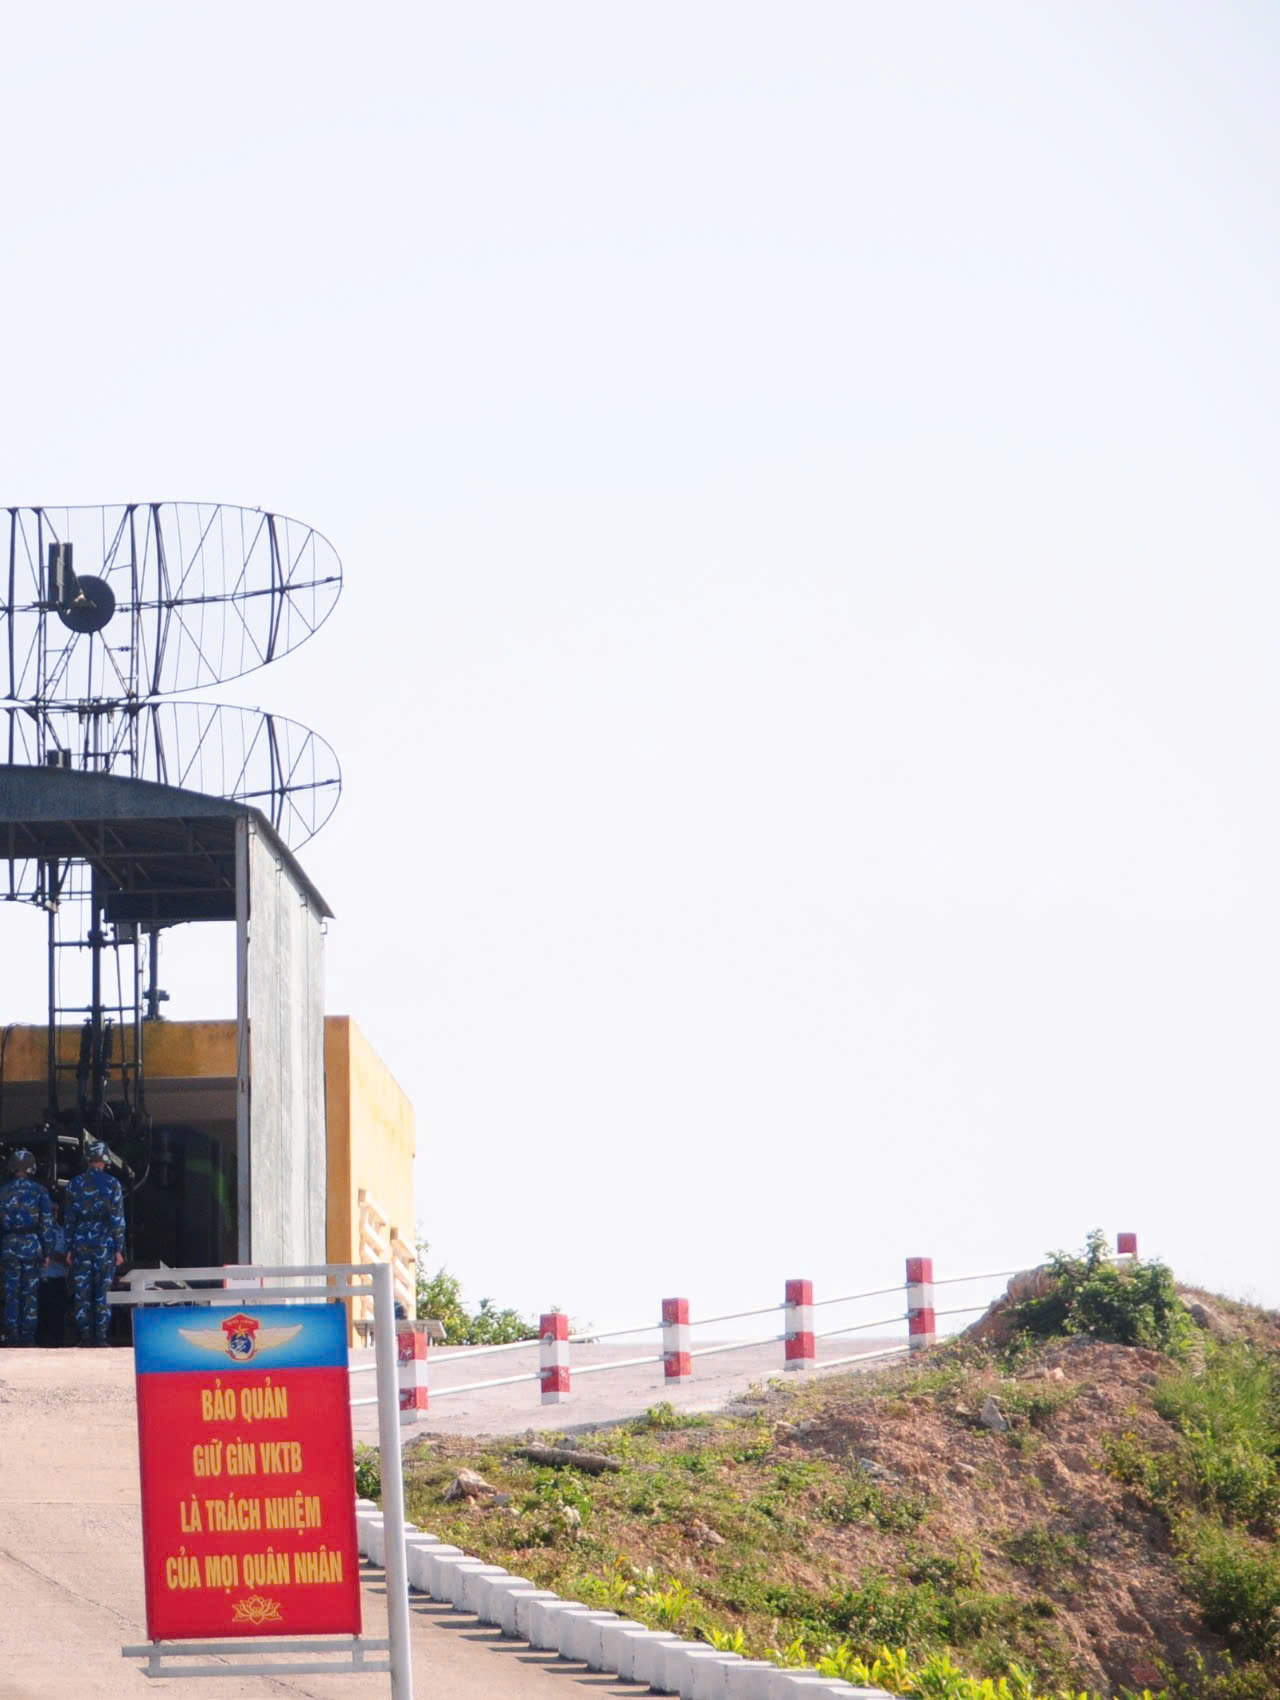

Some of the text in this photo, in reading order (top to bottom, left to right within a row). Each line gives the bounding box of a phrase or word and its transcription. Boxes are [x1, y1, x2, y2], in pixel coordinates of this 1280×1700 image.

[201, 1376, 288, 1423] BẢO QUẢN
[192, 1436, 303, 1477] GIỮ GÌN VKTB
[180, 1489, 321, 1536] LÀ TRÁCH NHIỆM
[166, 1544, 343, 1594] CỦA MỌI QUÂN NHÂN
